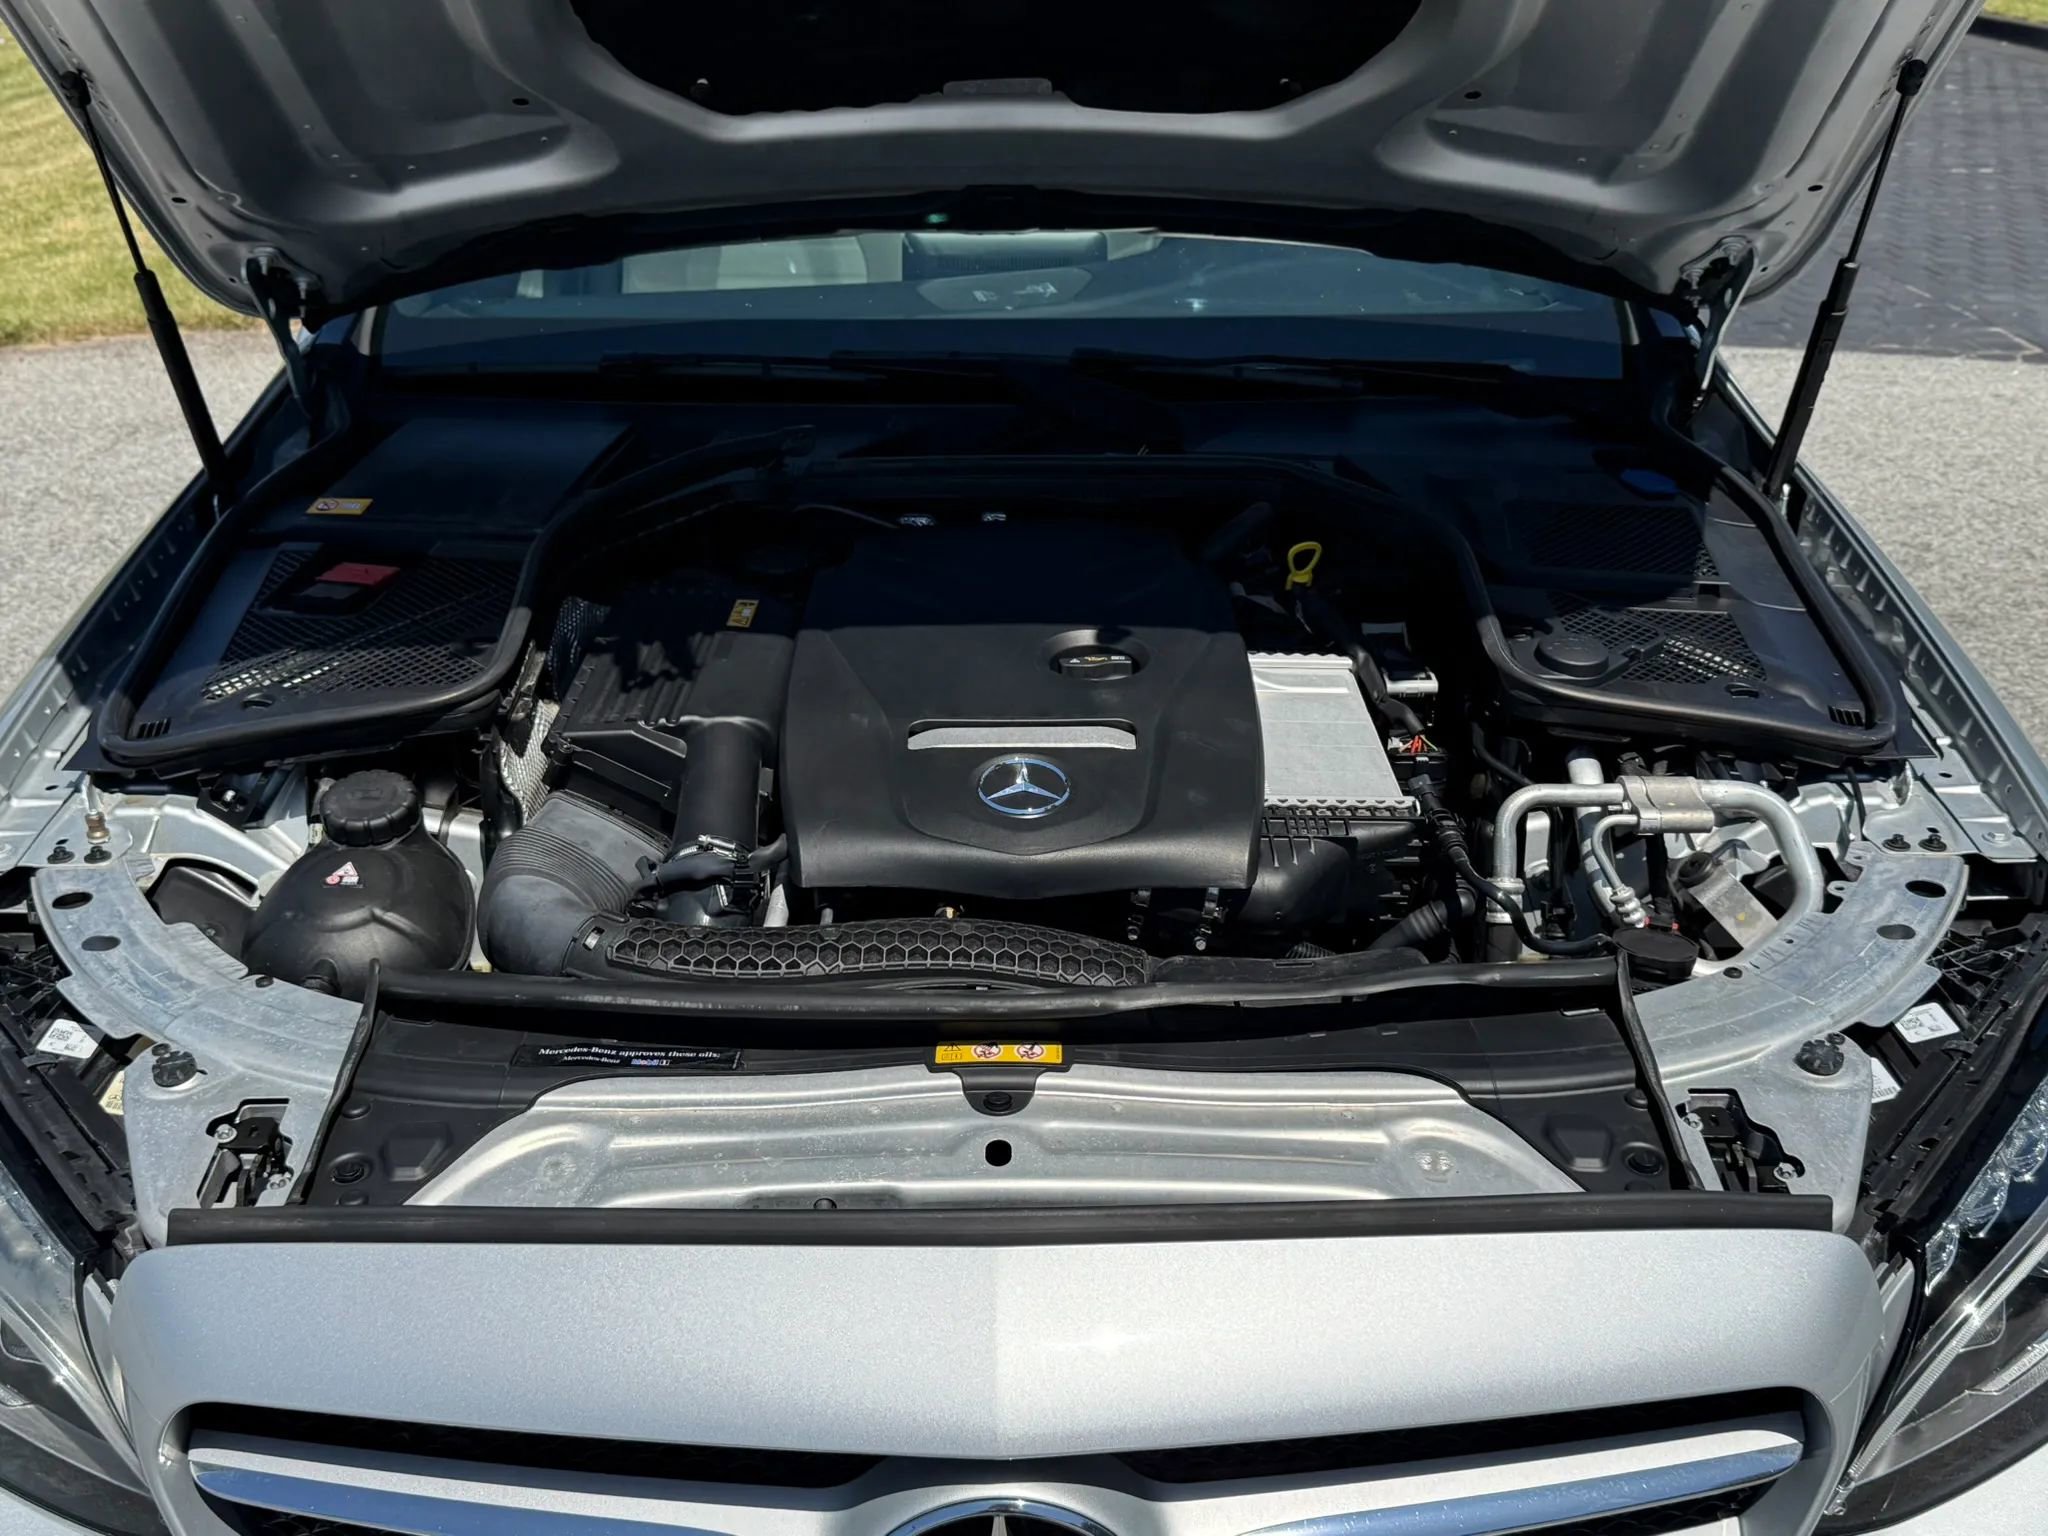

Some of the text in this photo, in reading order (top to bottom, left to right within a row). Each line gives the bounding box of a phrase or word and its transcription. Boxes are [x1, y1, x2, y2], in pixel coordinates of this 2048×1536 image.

[539, 1046, 617, 1056] Mercedes-Benz
[619, 1050, 666, 1058] approves
[668, 1050, 697, 1058] these
[562, 1055, 621, 1064] Mercedes-Benz
